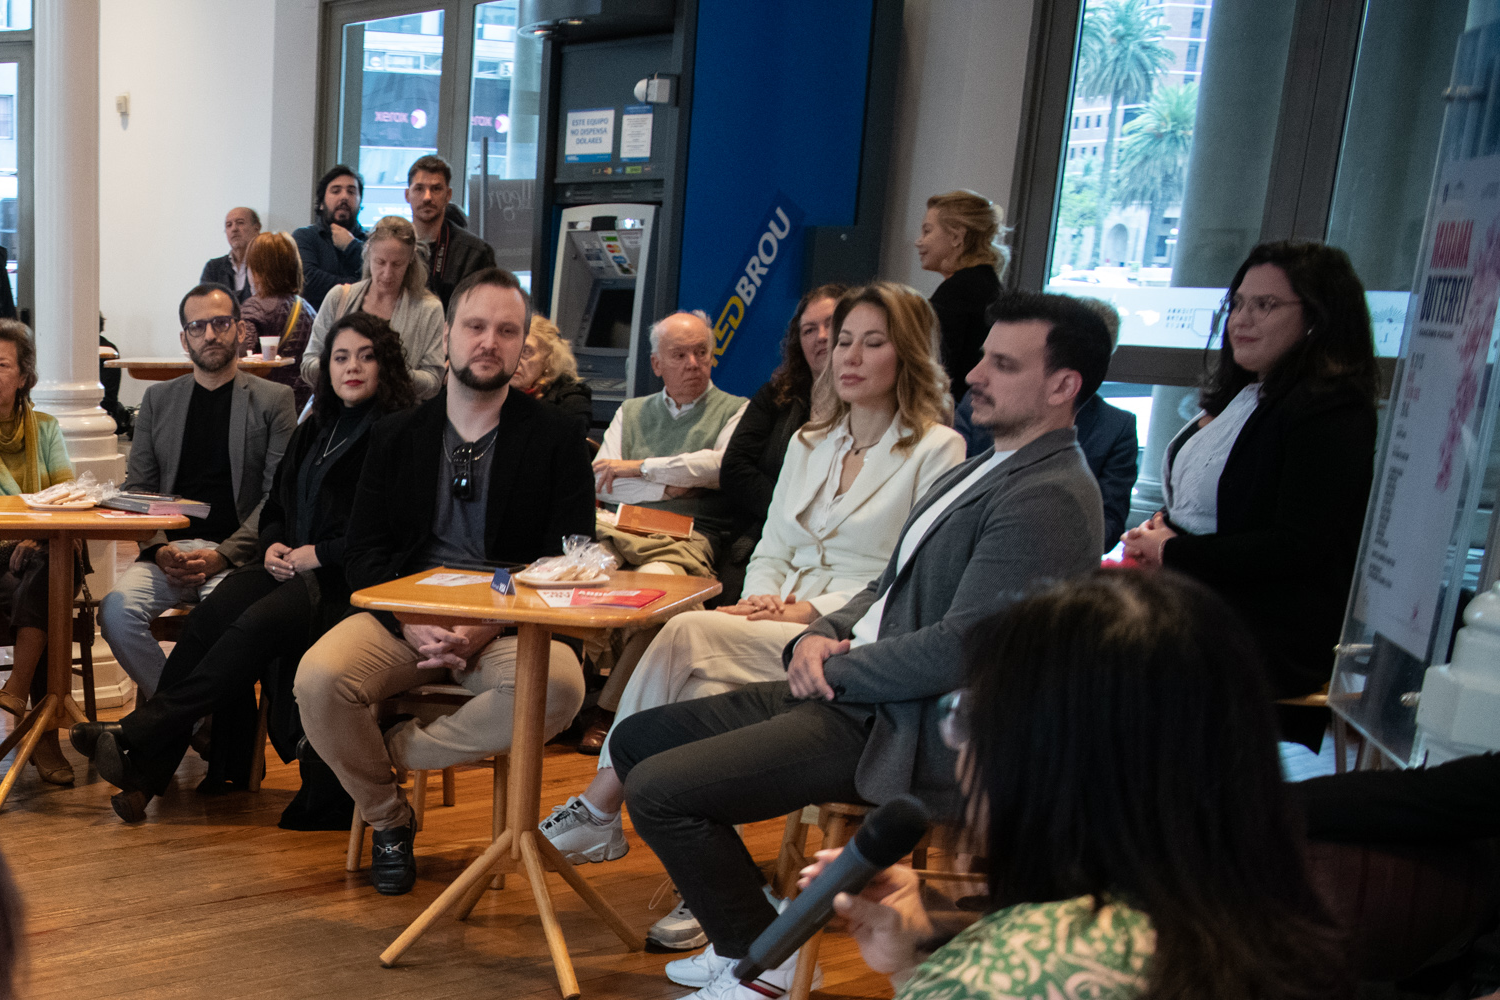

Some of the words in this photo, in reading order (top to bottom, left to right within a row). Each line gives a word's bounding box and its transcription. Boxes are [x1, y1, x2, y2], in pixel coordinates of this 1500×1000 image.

[374, 111, 409, 123] xerox
[571, 119, 586, 127] ESTE
[586, 117, 609, 126] EQUIPO
[570, 128, 580, 136] NO
[580, 127, 608, 135] DISPENSA
[1430, 219, 1475, 270] MADAMA
[1419, 275, 1475, 326] BUTTERFLY
